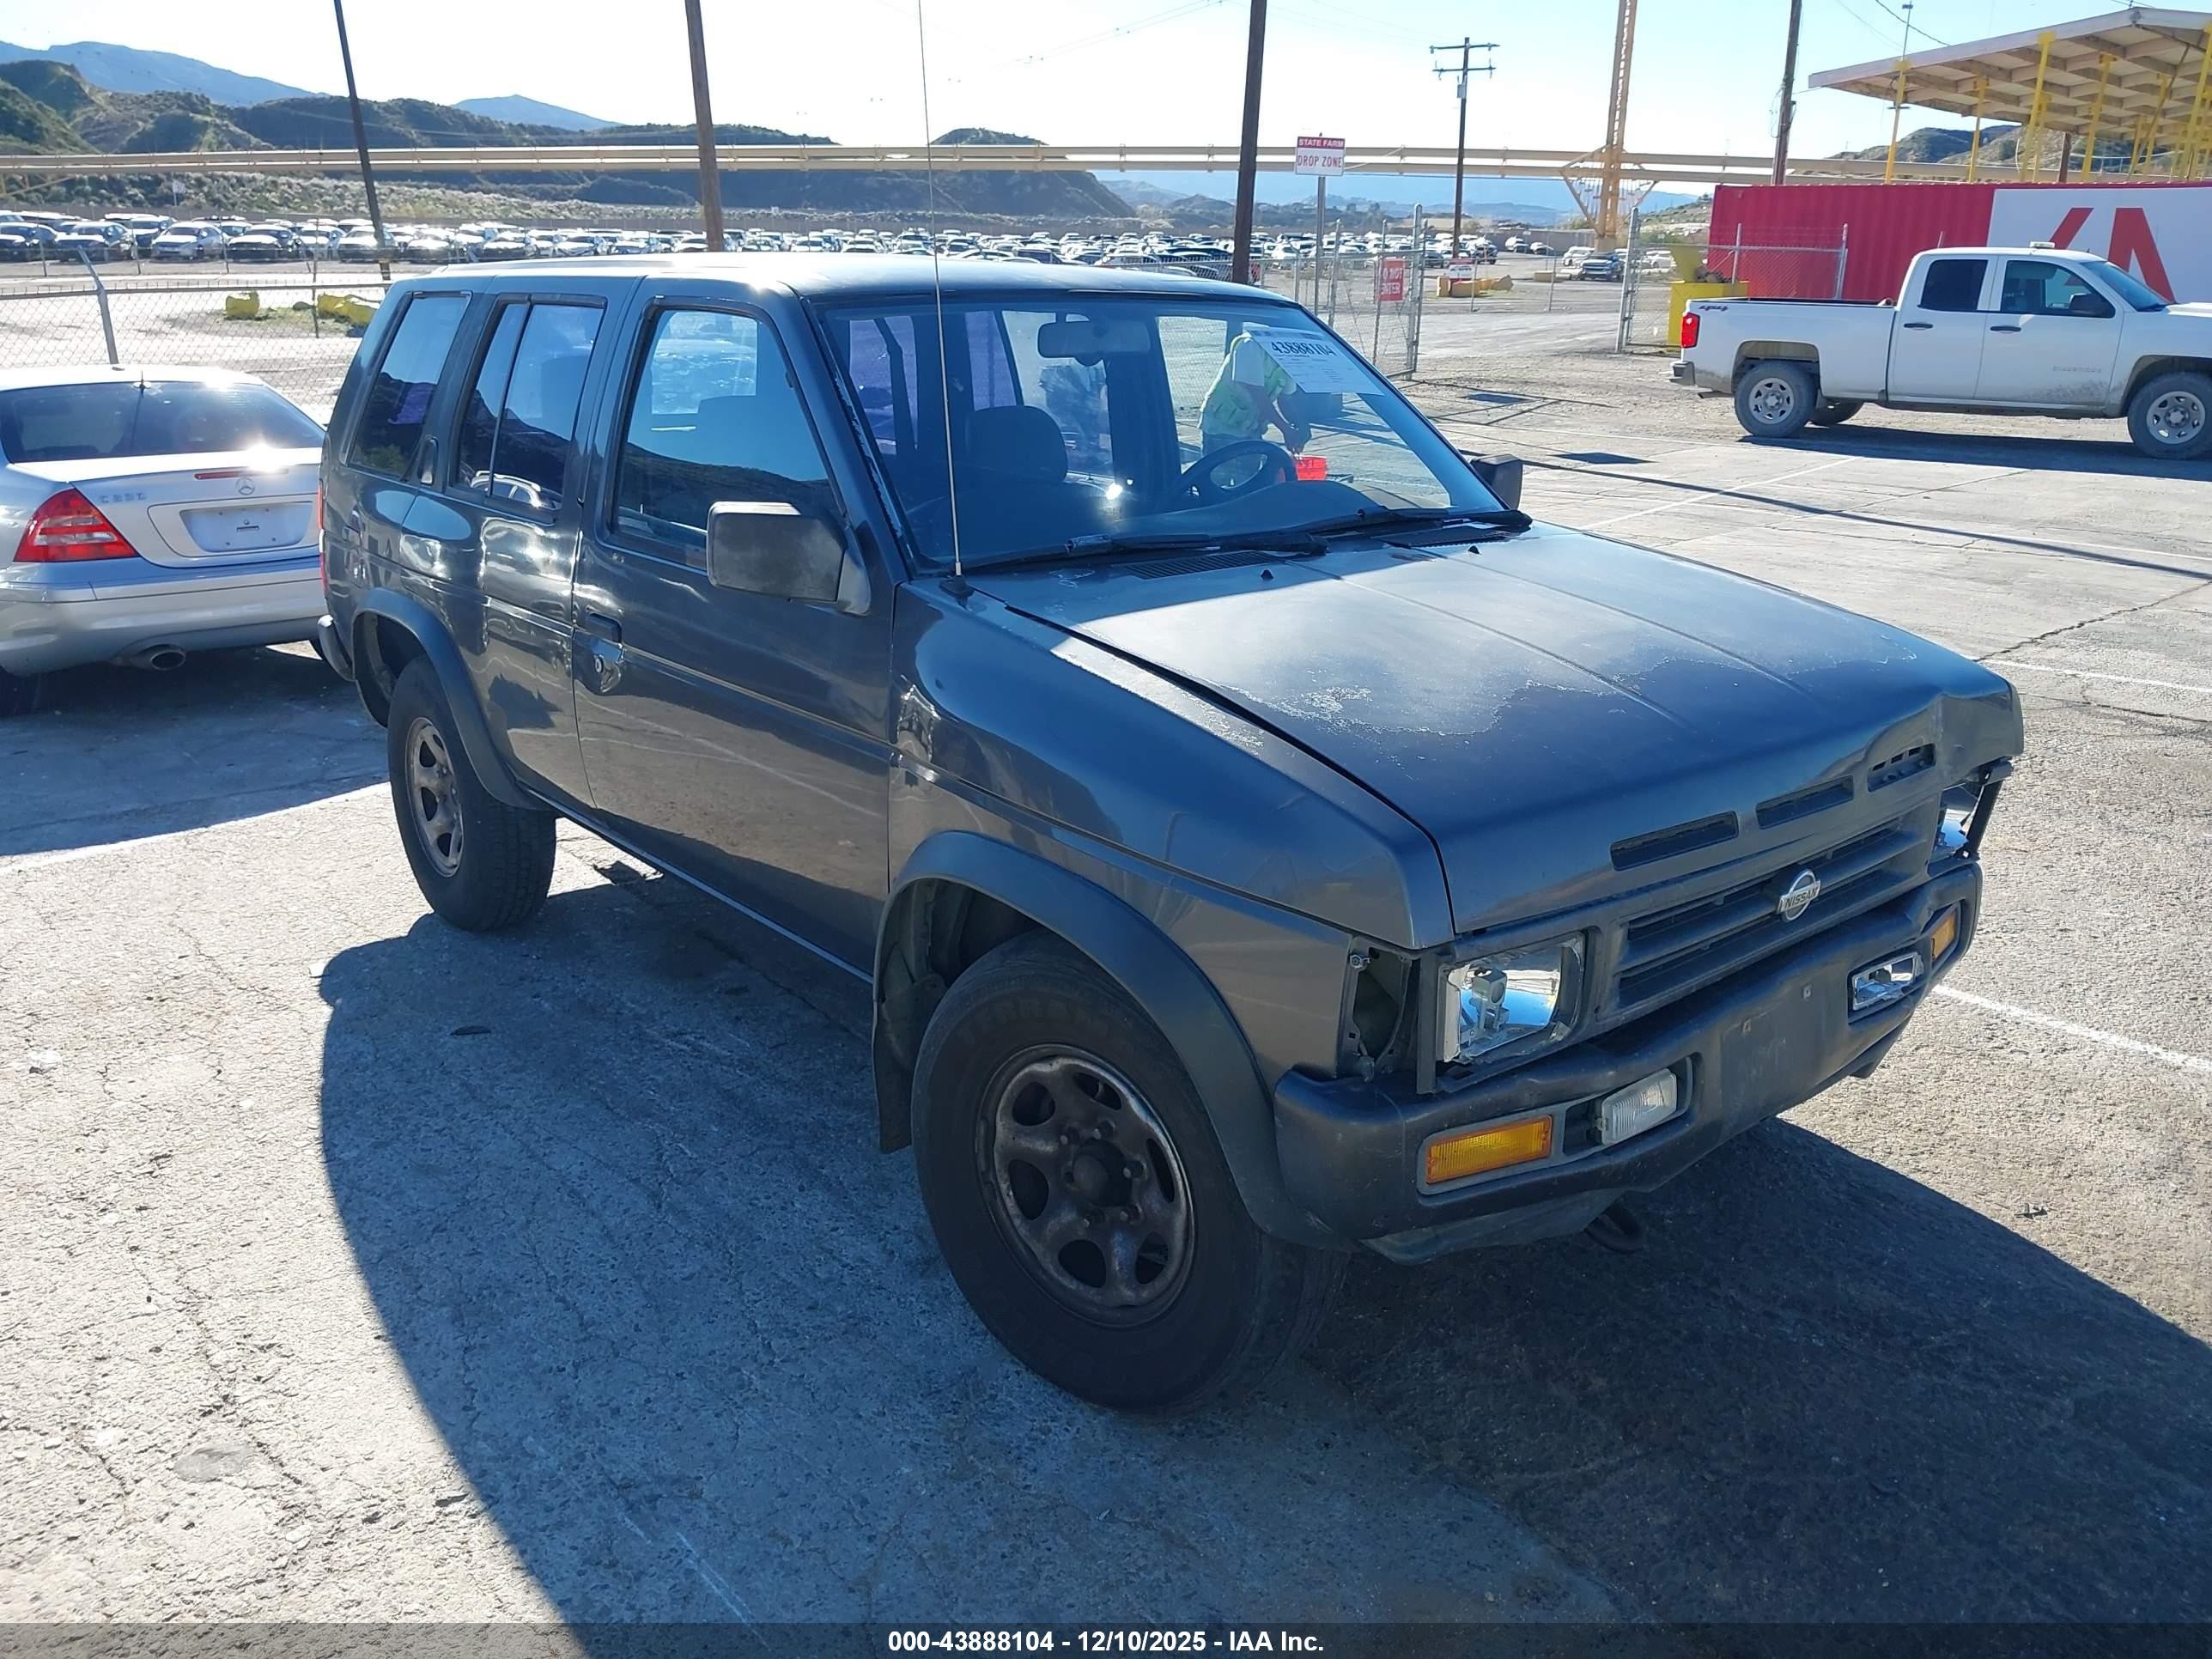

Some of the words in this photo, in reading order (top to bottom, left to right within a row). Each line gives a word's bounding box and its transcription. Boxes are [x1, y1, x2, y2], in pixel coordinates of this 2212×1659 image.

[1298, 138, 1322, 147] STATE
[1297, 155, 1319, 167] DROP
[1322, 155, 1342, 167] ZONE
[1270, 341, 1338, 357] 43888104
[1784, 885, 1819, 908] NISSAN
